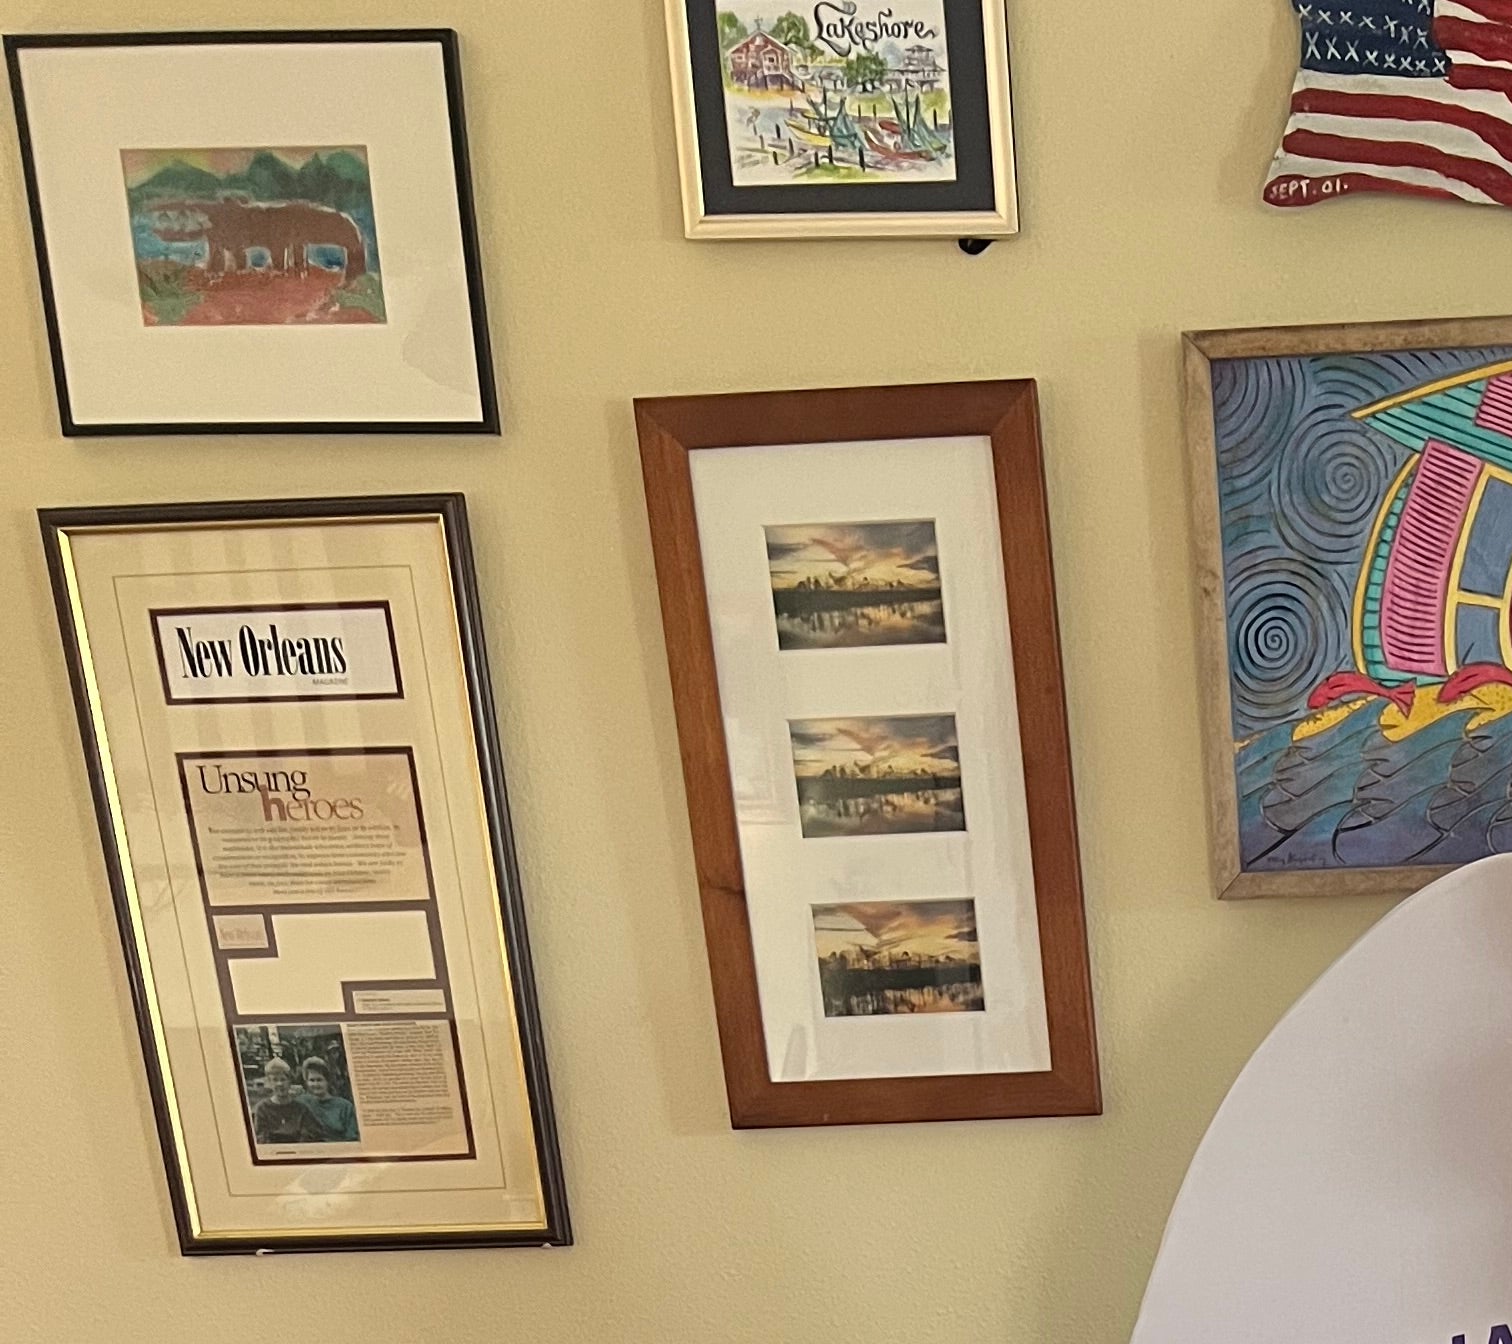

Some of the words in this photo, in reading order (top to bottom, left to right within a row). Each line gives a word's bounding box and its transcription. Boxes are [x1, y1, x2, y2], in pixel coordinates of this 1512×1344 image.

[813, 1, 937, 57] Lakeshore
[175, 626, 233, 679] New
[238, 624, 347, 677] Orleans
[197, 764, 311, 801] Unsung
[261, 784, 364, 822] heroes
